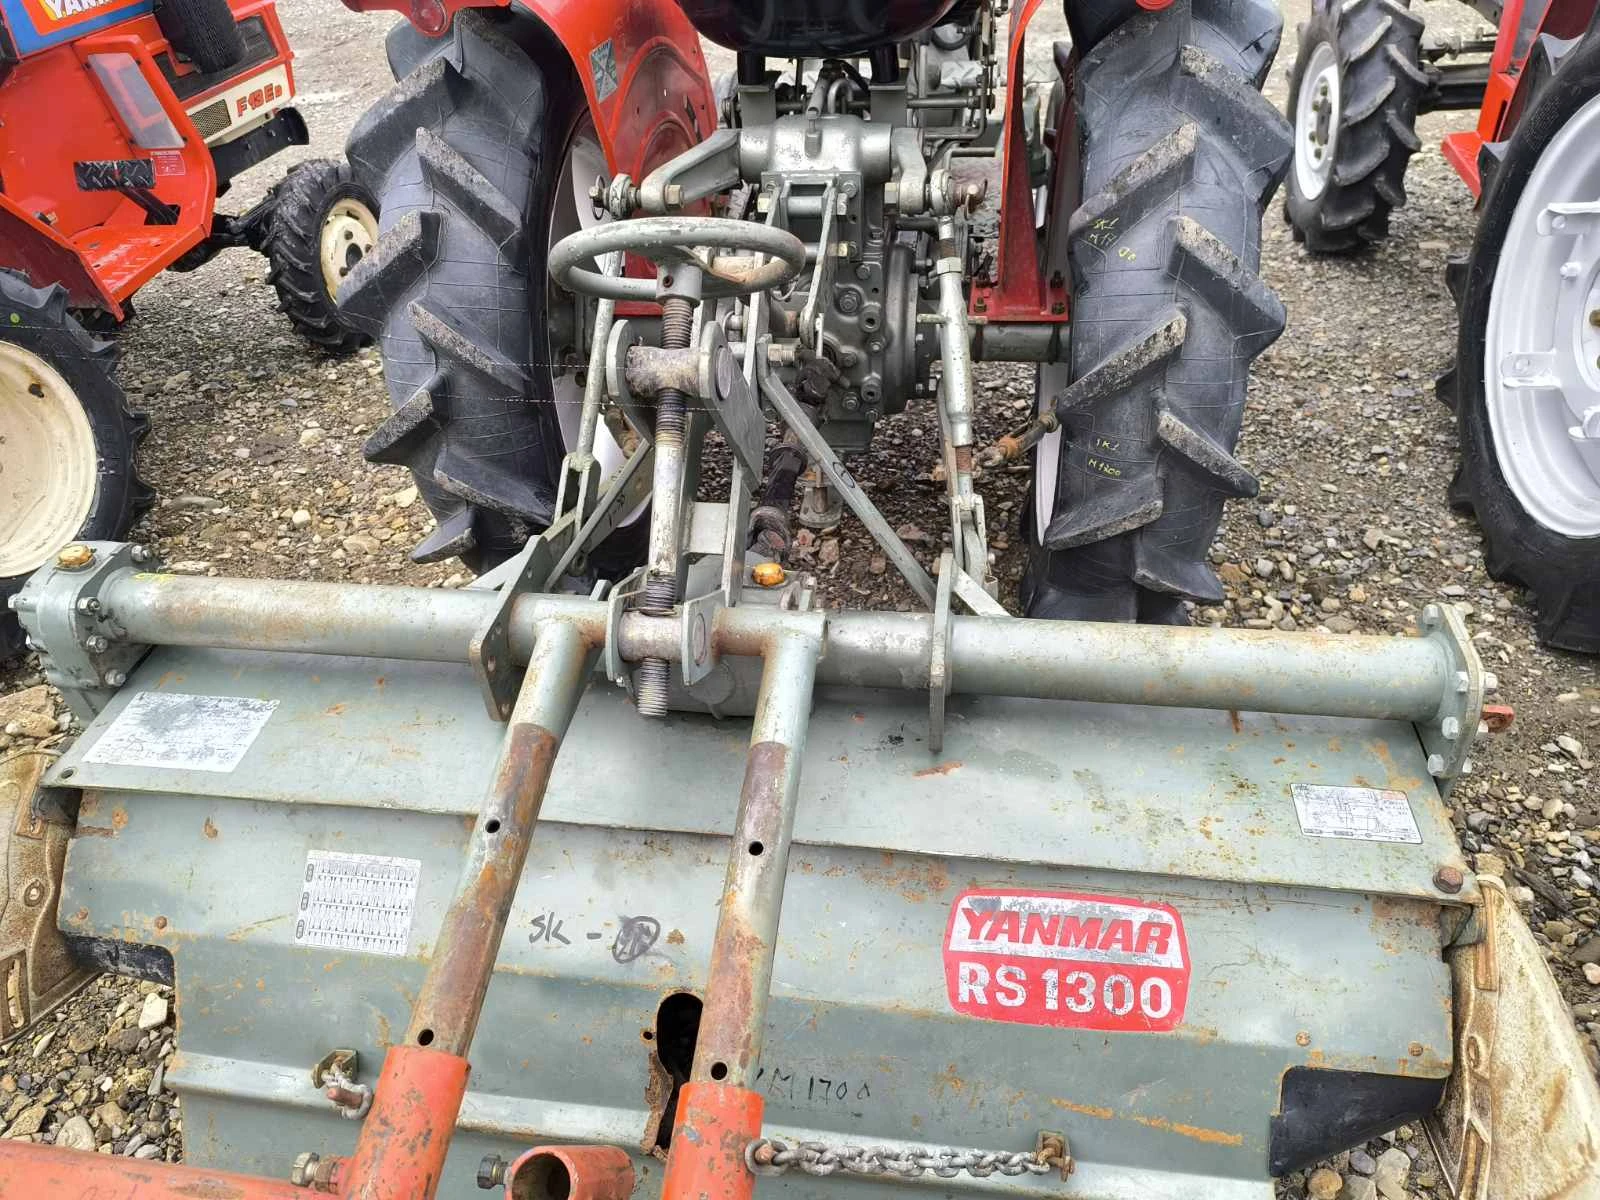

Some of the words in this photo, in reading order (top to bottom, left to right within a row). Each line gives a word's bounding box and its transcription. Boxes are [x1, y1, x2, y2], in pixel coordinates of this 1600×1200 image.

[961, 907, 1174, 955] YANMAR
[958, 961, 1027, 1007] RS
[1041, 967, 1172, 1019] 1300
